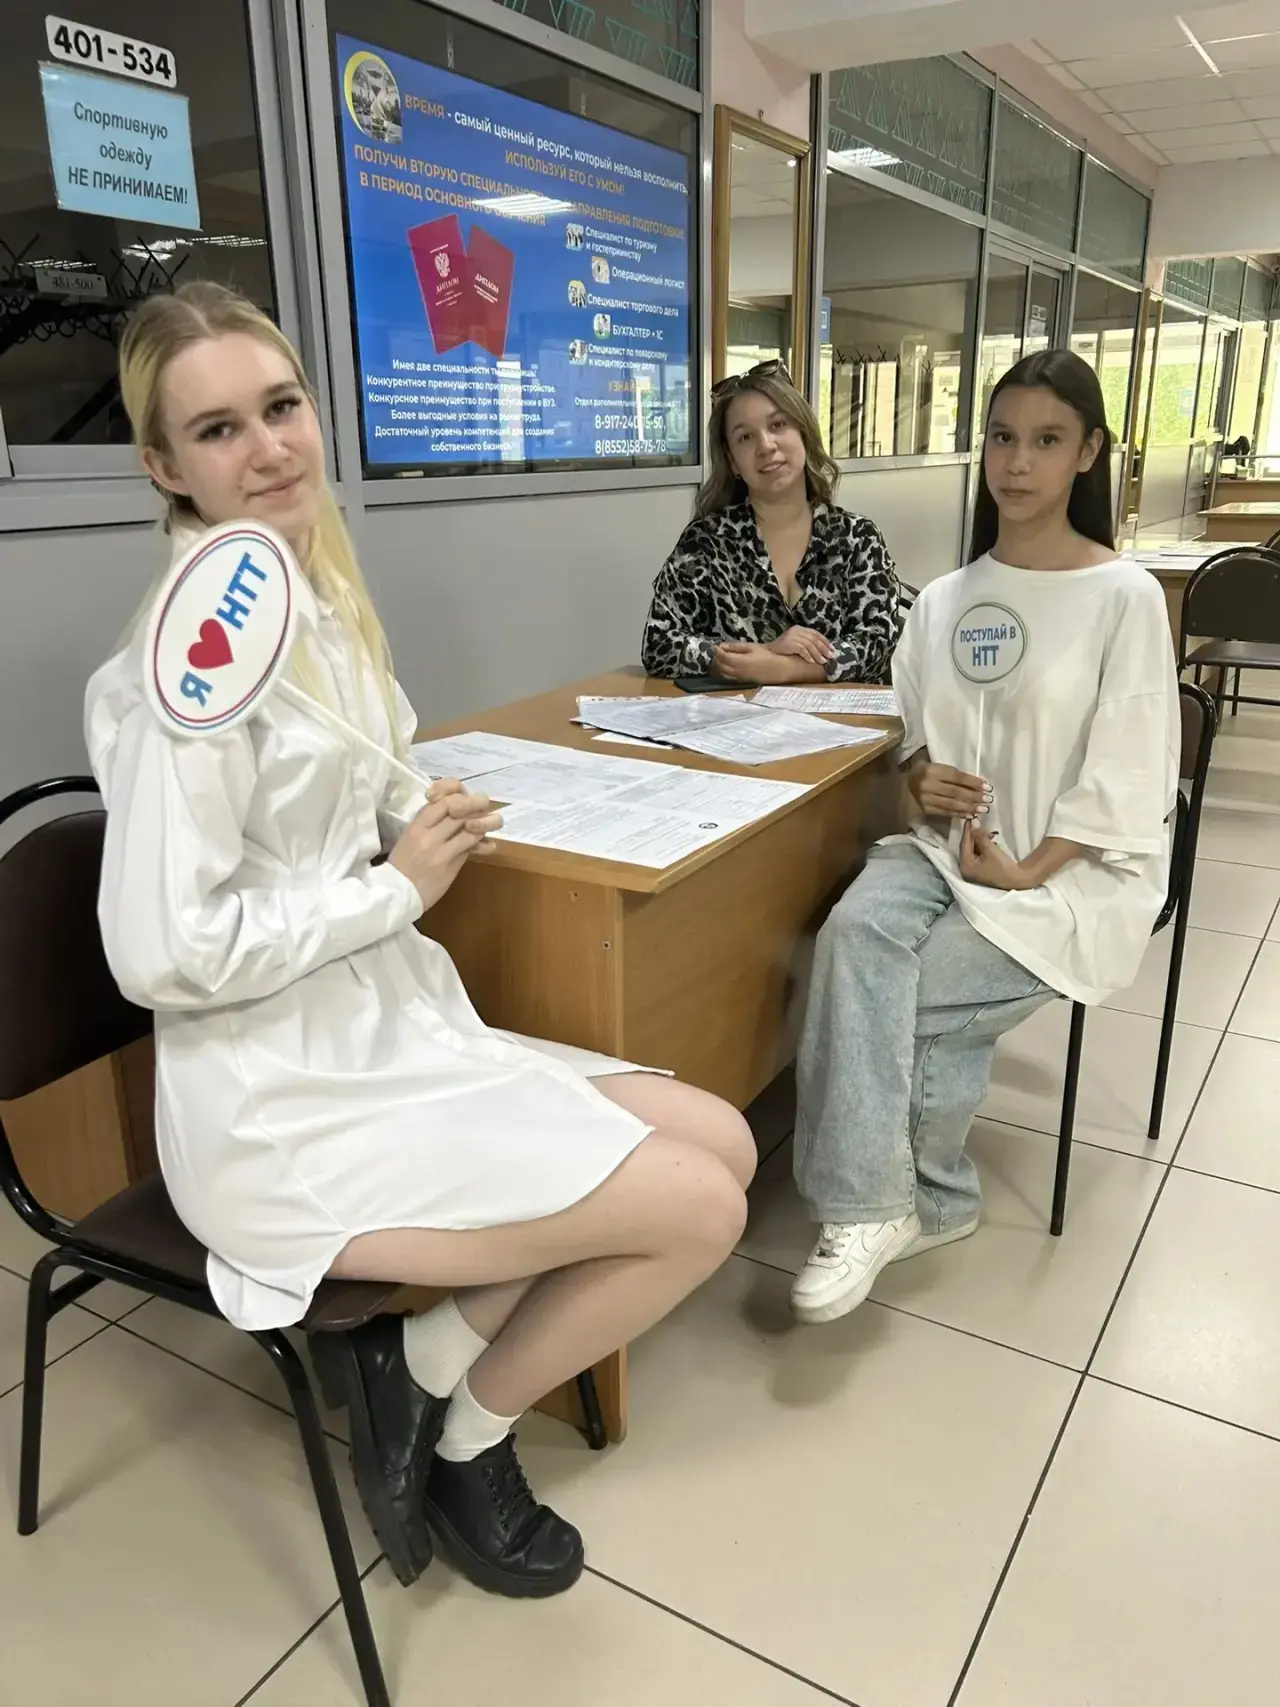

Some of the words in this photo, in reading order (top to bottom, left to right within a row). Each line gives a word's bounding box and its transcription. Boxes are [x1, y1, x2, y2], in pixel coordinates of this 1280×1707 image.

[53, 24, 172, 80] 401-534
[74, 101, 168, 140] Спортивную
[405, 94, 445, 119] ВРЕМЯ
[454, 111, 492, 134] самый
[494, 125, 535, 147] ценный
[537, 137, 574, 160] ресурс,
[574, 150, 612, 171] который
[613, 162, 642, 180] нельзя
[99, 142, 152, 170] одежду
[354, 144, 407, 171] ПОЛУЧИ
[410, 159, 458, 184] ВТОРУЮ
[461, 172, 544, 199] СПЕЦИАЛЬНО
[505, 150, 567, 179] ИСПОЛЬЗУЙ
[568, 169, 585, 185] ЕГО
[587, 174, 594, 188] С
[595, 176, 625, 195] УМОМ!
[68, 166, 88, 187] НЕ
[93, 171, 188, 205] ПРИНИМАЕМ!
[359, 171, 369, 187] В
[372, 175, 423, 201] ПЕРИОД
[585, 226, 624, 244] Специалист
[624, 237, 633, 246] по
[633, 239, 658, 254] туризму
[591, 243, 641, 262] гостеприимству
[612, 266, 663, 286] Операционный
[664, 278, 685, 290] логист
[587, 293, 631, 309] Специалист
[631, 302, 663, 315] торгового
[663, 306, 679, 317] дела
[612, 324, 651, 338] БУХГАЛТЕР
[588, 343, 626, 356] Специалист
[626, 348, 635, 356] по
[392, 359, 415, 371] Имея
[416, 362, 431, 372] две
[433, 364, 490, 375] специальности
[588, 358, 594, 366] и
[594, 359, 641, 372] кондитерскому
[366, 375, 427, 389] Конкурентное
[428, 379, 484, 391] преимущество
[485, 382, 498, 391] при
[368, 391, 419, 405] Конкурсное
[420, 395, 477, 407] преимущество
[478, 398, 492, 407] при
[391, 409, 416, 420] Более
[418, 410, 457, 421] выгодные
[458, 412, 488, 422] условия
[375, 425, 430, 438] Достаточный
[430, 427, 463, 438] уровень
[525, 428, 555, 437] создания
[431, 441, 482, 452] собственного
[595, 439, 667, 457] 8(8552)58-75-78
[179, 671, 214, 707] Я
[216, 551, 268, 631] НТТ
[960, 623, 1007, 643] ПОСТУПАЙ
[1009, 626, 1016, 640] В
[972, 644, 1000, 667] НТТ
